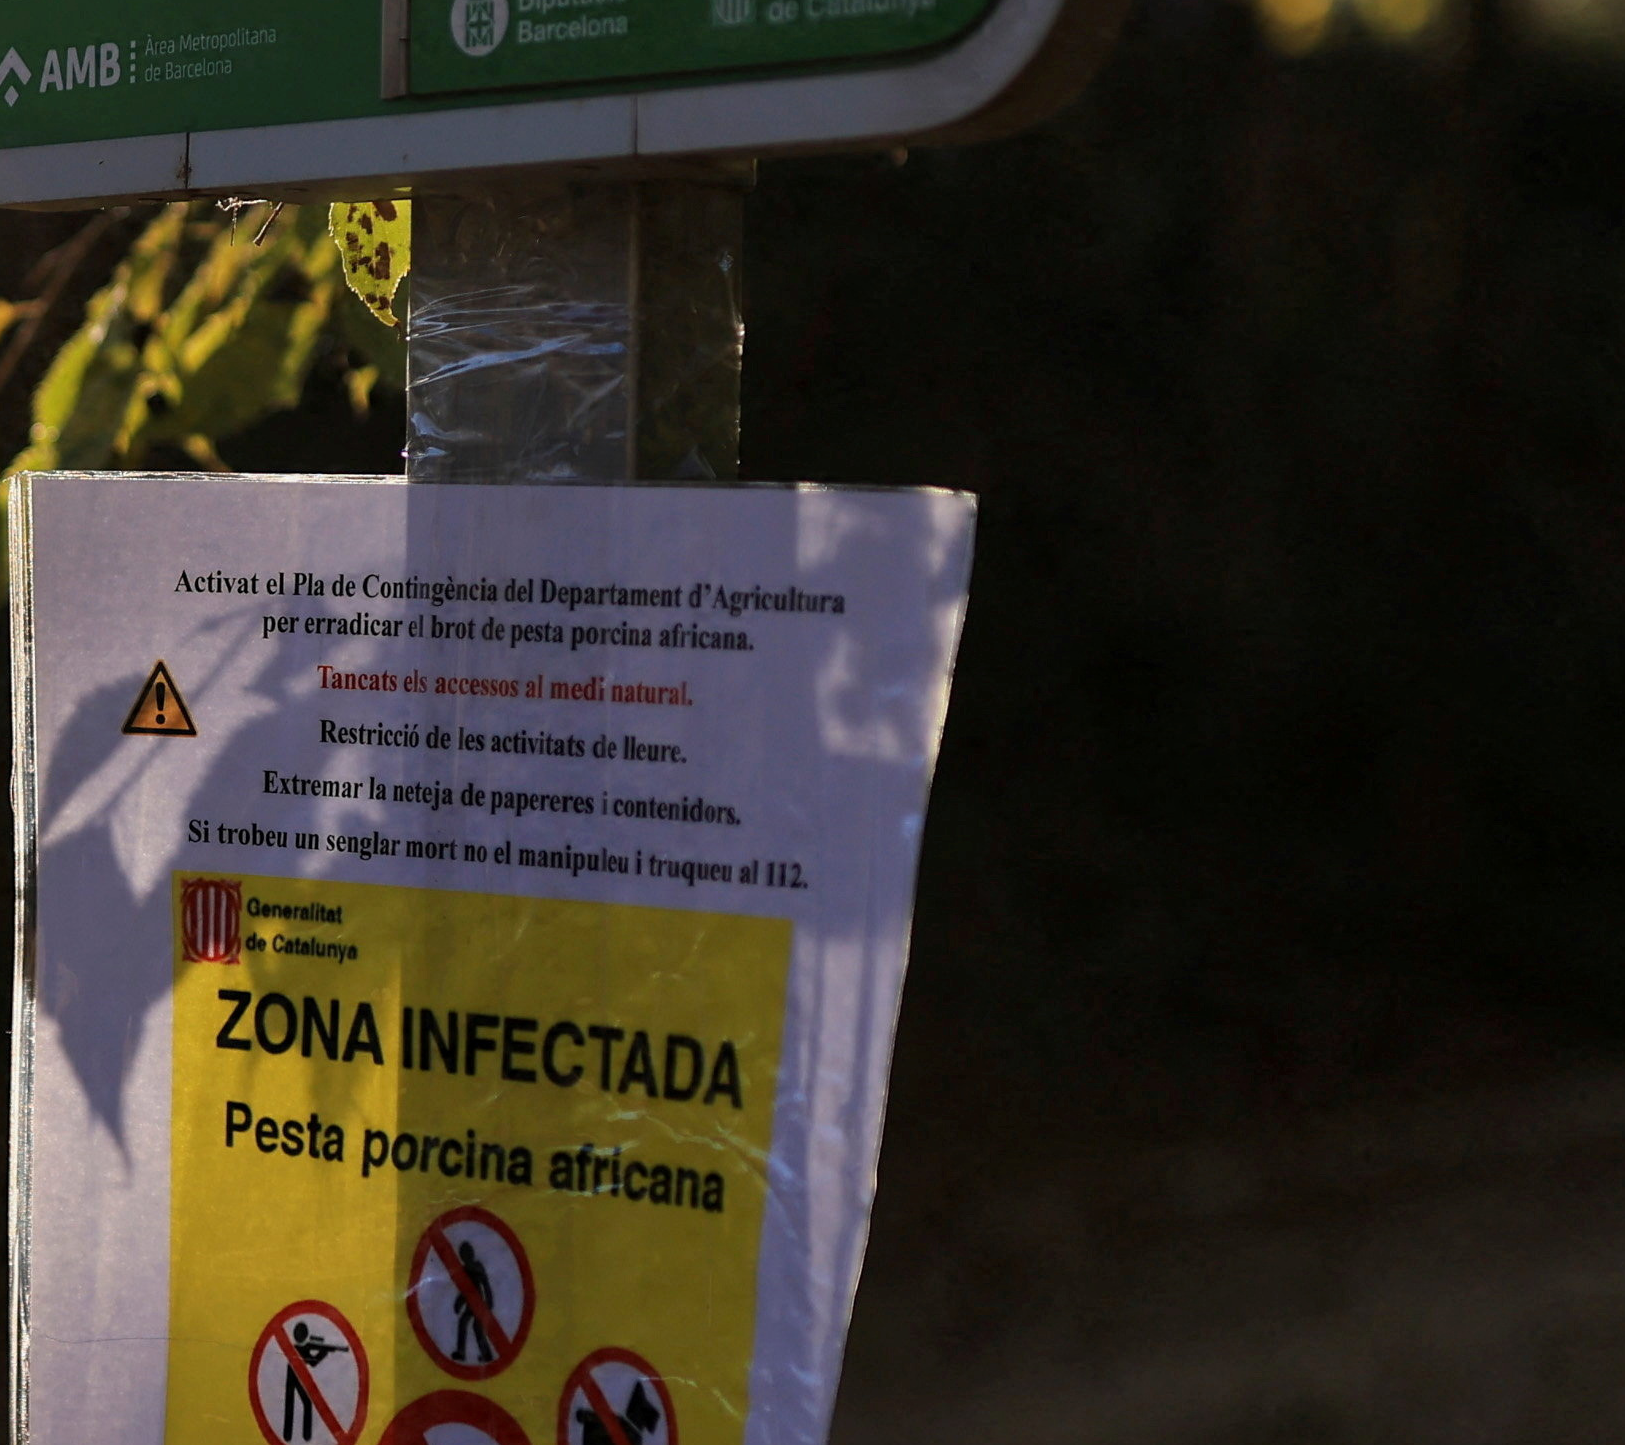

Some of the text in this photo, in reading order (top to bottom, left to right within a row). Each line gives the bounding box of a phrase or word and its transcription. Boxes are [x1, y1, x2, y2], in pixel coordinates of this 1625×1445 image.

[145, 28, 277, 55] Àrea Metropolitana
[517, 12, 628, 44] Barcelona
[39, 42, 121, 93] AMB
[144, 58, 232, 82] de Barcelona
[174, 570, 258, 595] Activat
[266, 572, 284, 596] el
[293, 572, 324, 596] Pla
[331, 574, 355, 597] de
[362, 573, 498, 606] Contingència
[505, 578, 534, 603] del
[541, 579, 682, 611] Departament
[262, 612, 755, 651] per erradicar el brot de pesta porcina africana.
[317, 665, 694, 706] Tancats els accessos al medi natural.
[319, 719, 687, 764] Restricció de les activitats de lleure.
[263, 770, 741, 826] Extremar la neteja de papereres i contenidors.
[188, 819, 808, 889] Si trobeu un senglar mort no el manipuleu i truqueu al 112.
[247, 896, 343, 925] Generalitat
[245, 932, 358, 965] de Catalunya
[216, 989, 743, 1110] ZONA INFECTADA
[224, 1101, 725, 1214] Pesta porcina africana
